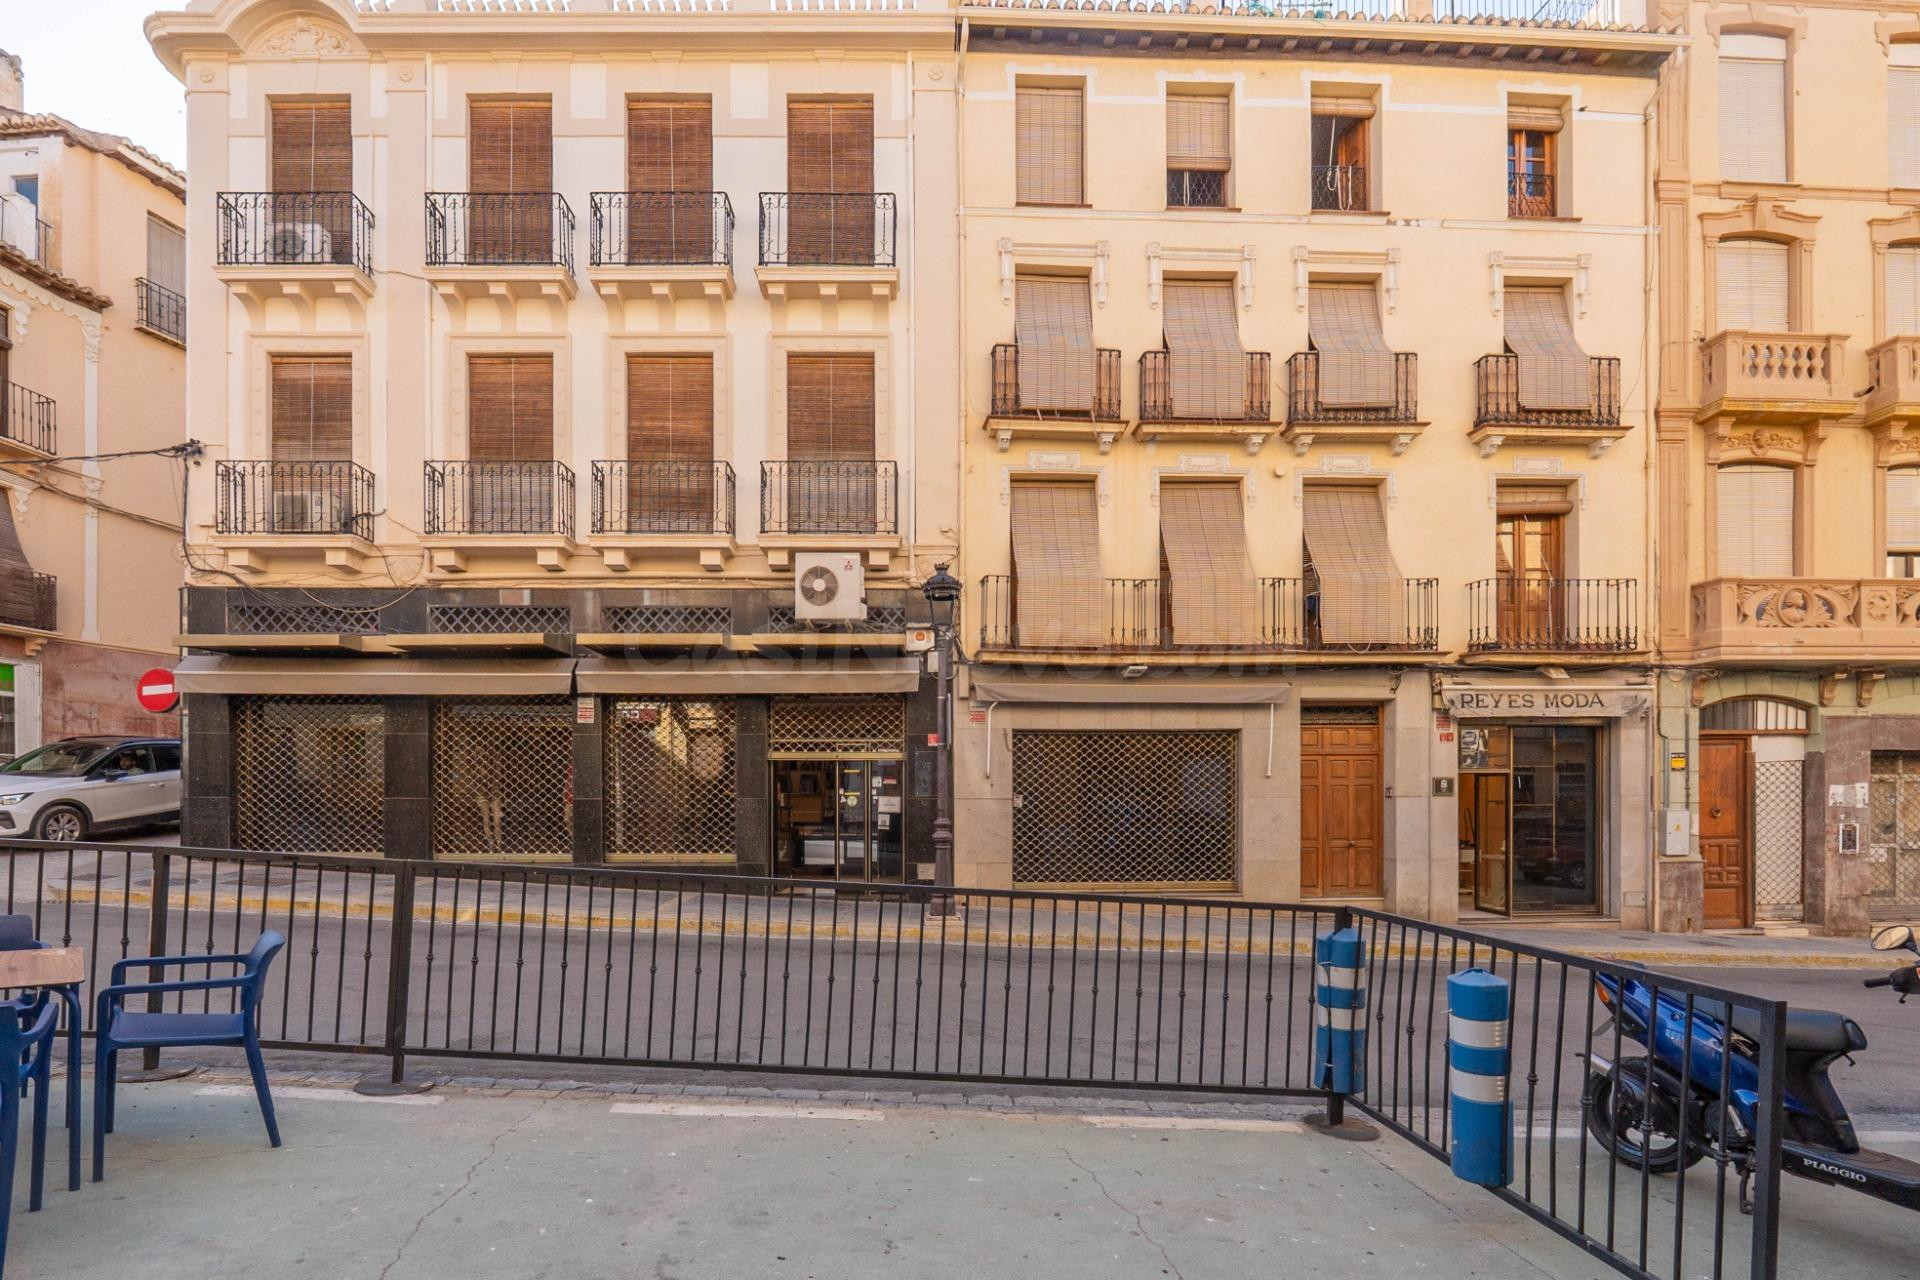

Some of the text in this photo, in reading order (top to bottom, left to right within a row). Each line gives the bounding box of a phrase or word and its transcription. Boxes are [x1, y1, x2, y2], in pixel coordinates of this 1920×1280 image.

[1460, 693, 1605, 709] REYES MODA
[1803, 1158, 1867, 1182] PIAGGIO
